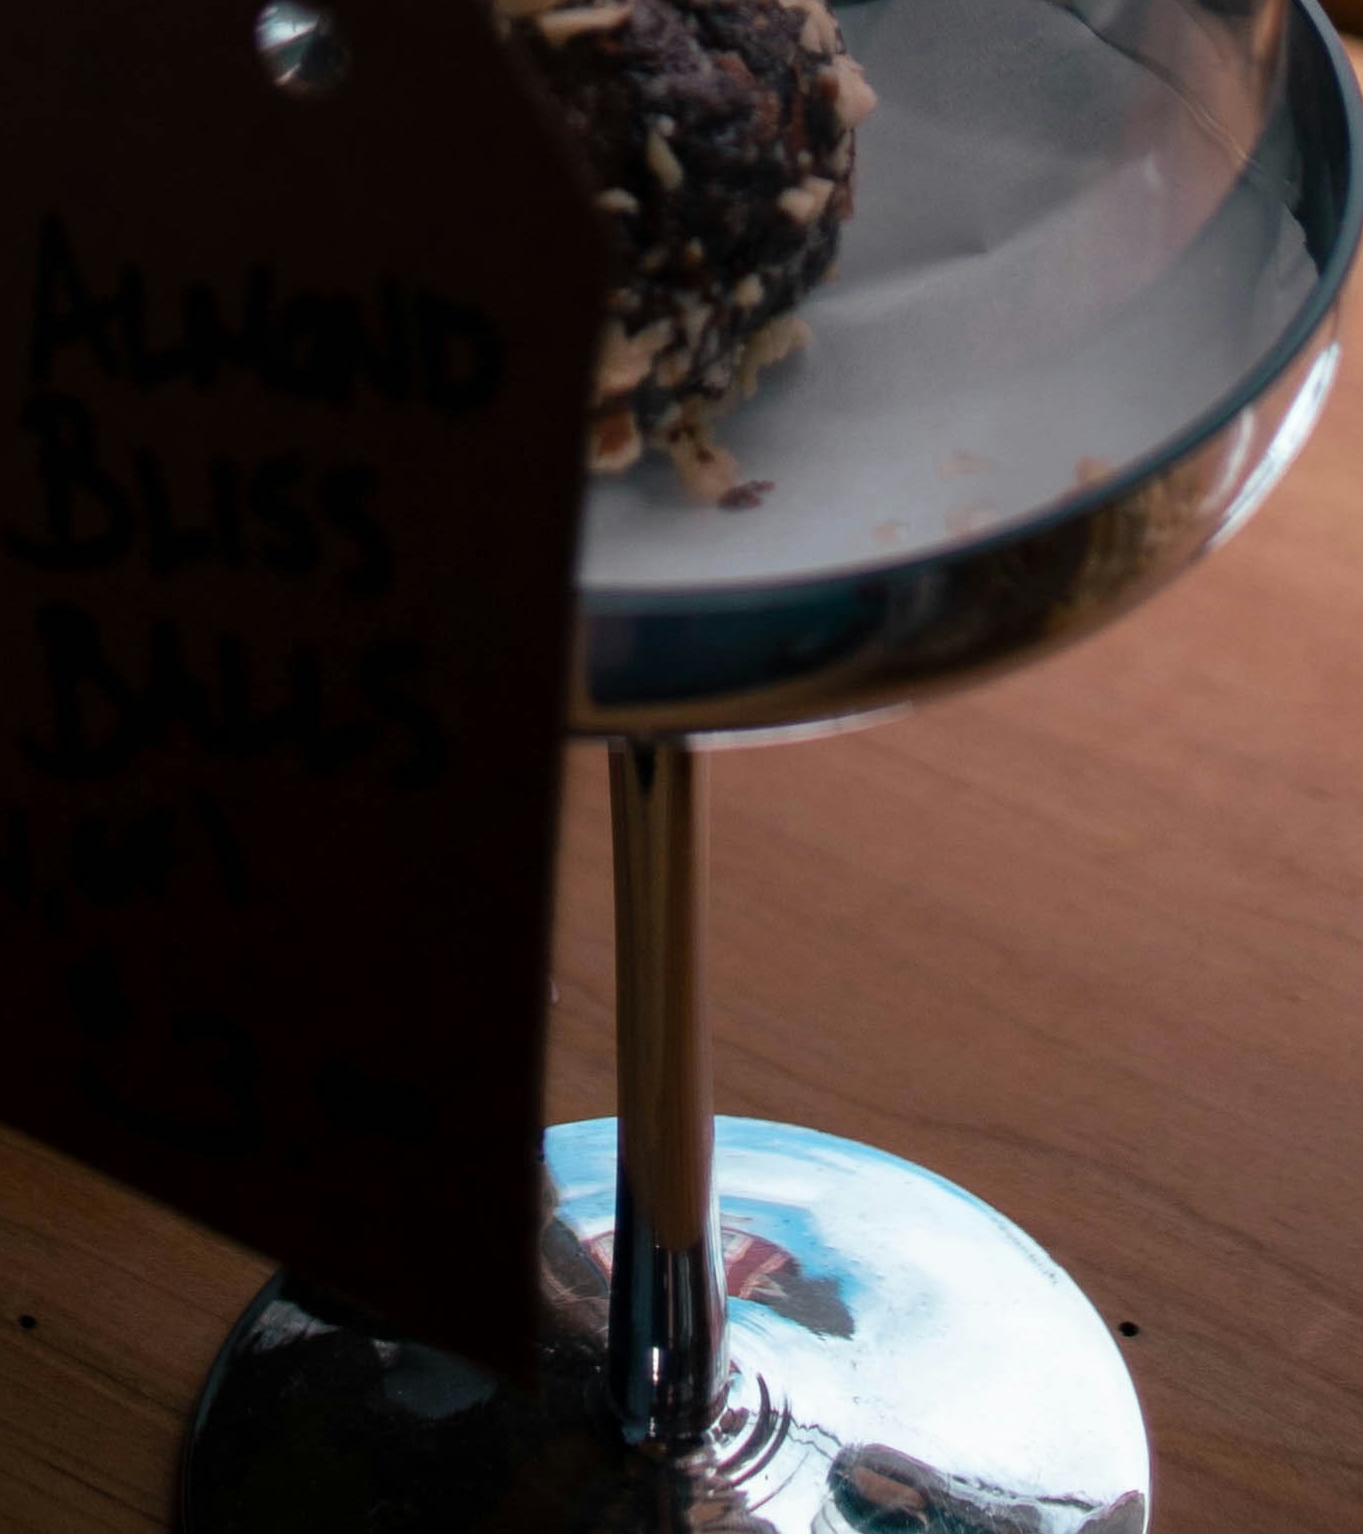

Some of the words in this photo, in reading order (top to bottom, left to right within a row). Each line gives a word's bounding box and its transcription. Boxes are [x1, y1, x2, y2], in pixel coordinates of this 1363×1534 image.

[33, 214, 506, 414] ALMOND
[1, 392, 390, 594] BLISS
[20, 603, 454, 788] BALLS
